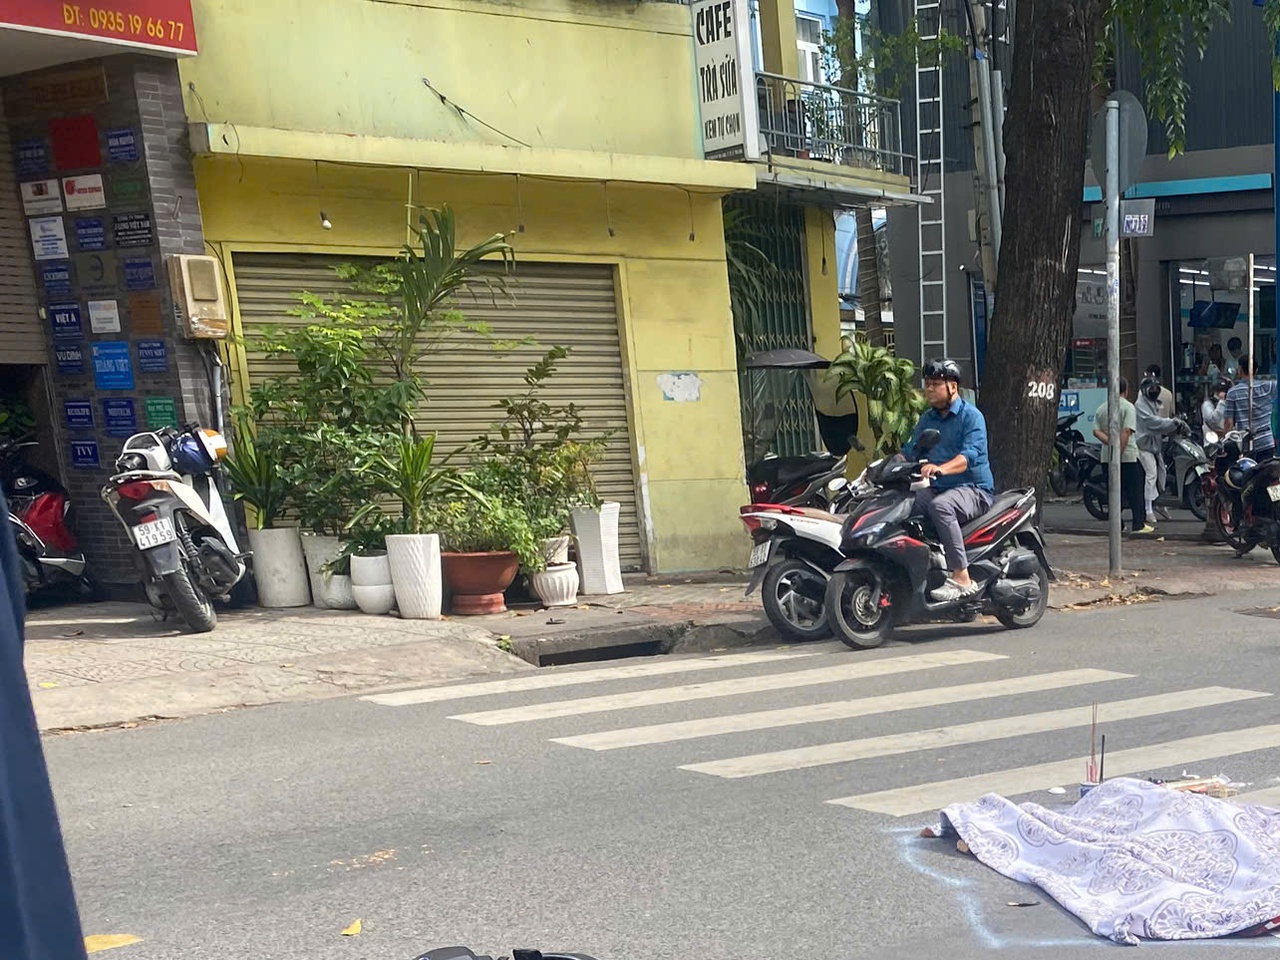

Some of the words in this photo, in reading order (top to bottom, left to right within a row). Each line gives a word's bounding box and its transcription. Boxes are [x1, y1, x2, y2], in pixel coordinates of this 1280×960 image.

[63, 4, 84, 26] ĐT:
[89, 8, 125, 32] 0935
[129, 14, 141, 34] 19
[147, 18, 164, 39] 66
[168, 21, 184, 41] 77
[696, 1, 731, 45] CAFE
[700, 58, 718, 103] TRÀ
[705, 118, 717, 140] KEM
[1028, 381, 1055, 400] 208
